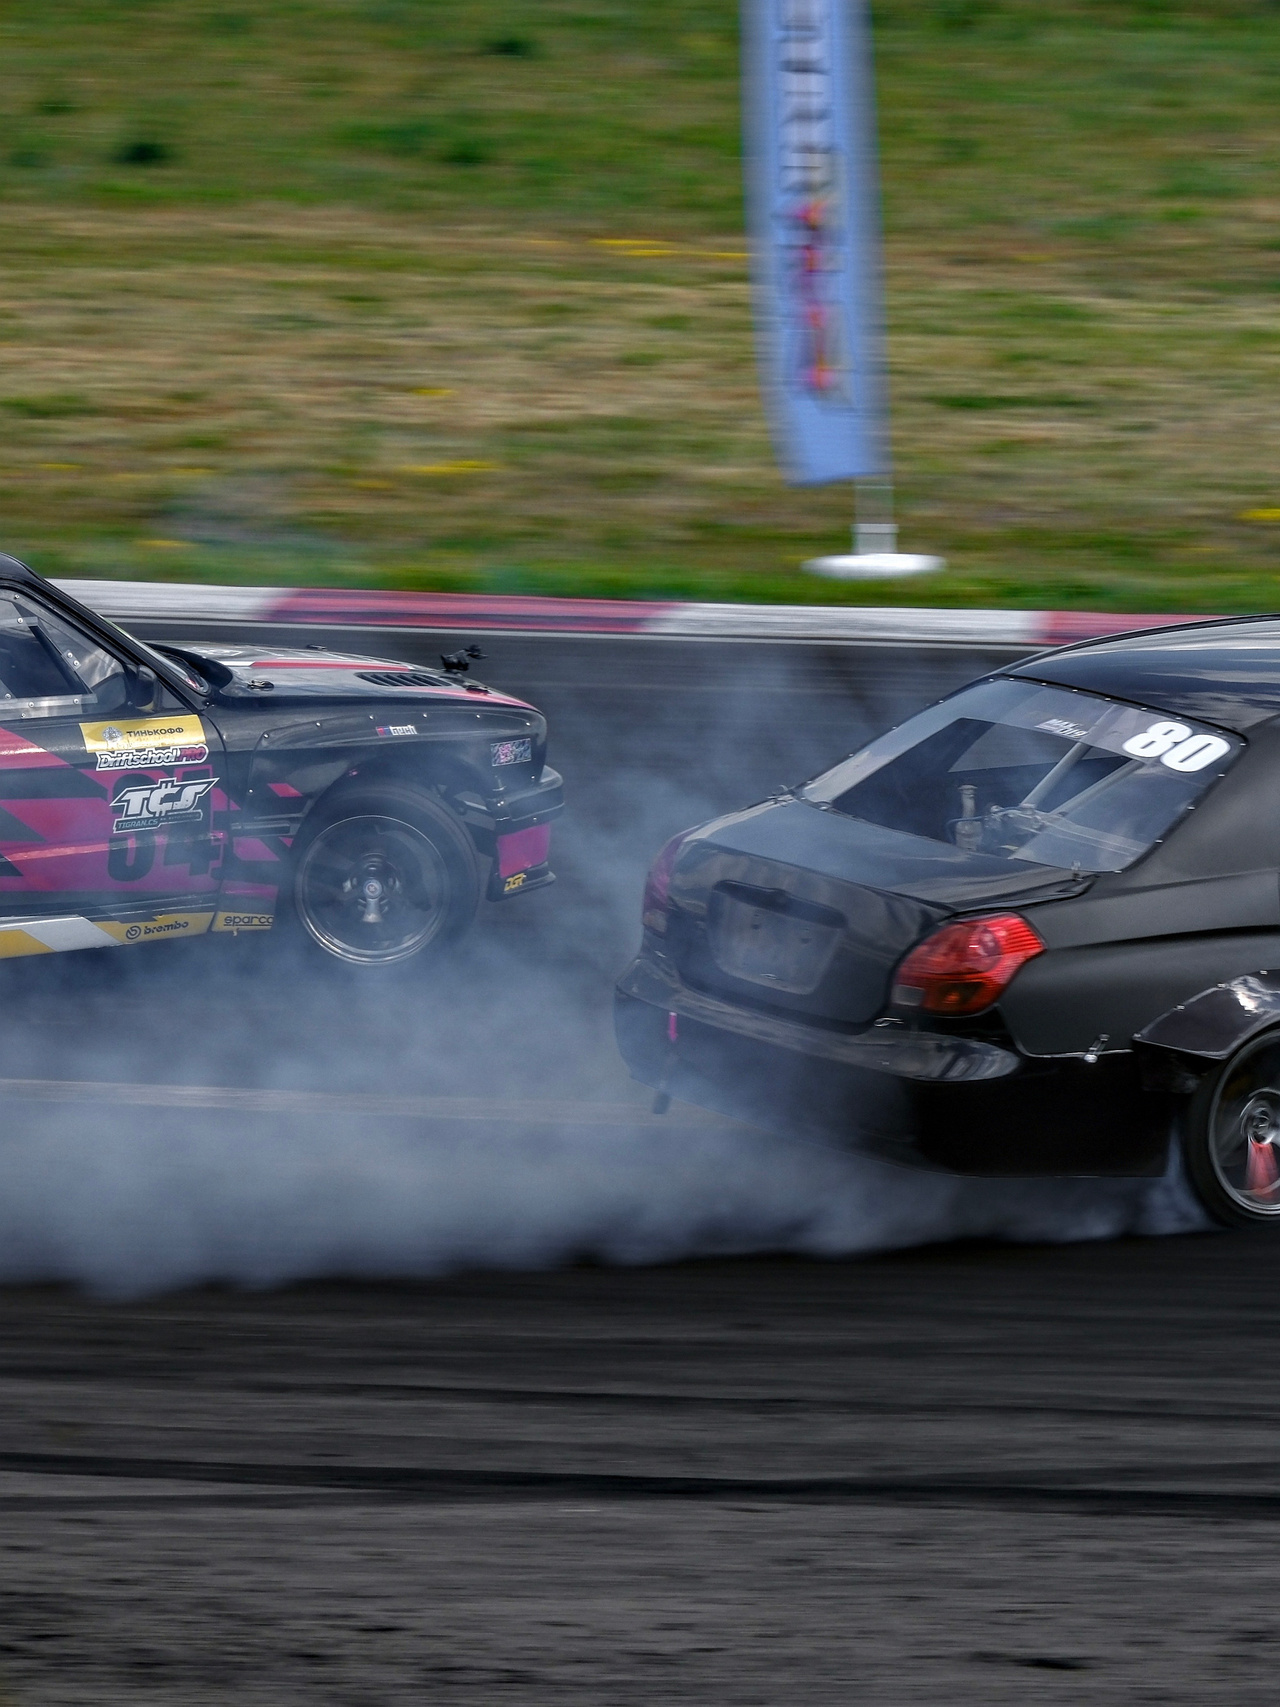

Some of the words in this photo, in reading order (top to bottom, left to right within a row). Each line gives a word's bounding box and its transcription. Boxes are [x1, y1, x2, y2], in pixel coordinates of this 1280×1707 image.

[126, 727, 184, 737] ТИНЬКОФФ
[1122, 721, 1231, 773] 80
[120, 782, 209, 817] TCS
[144, 921, 188, 934] brembo
